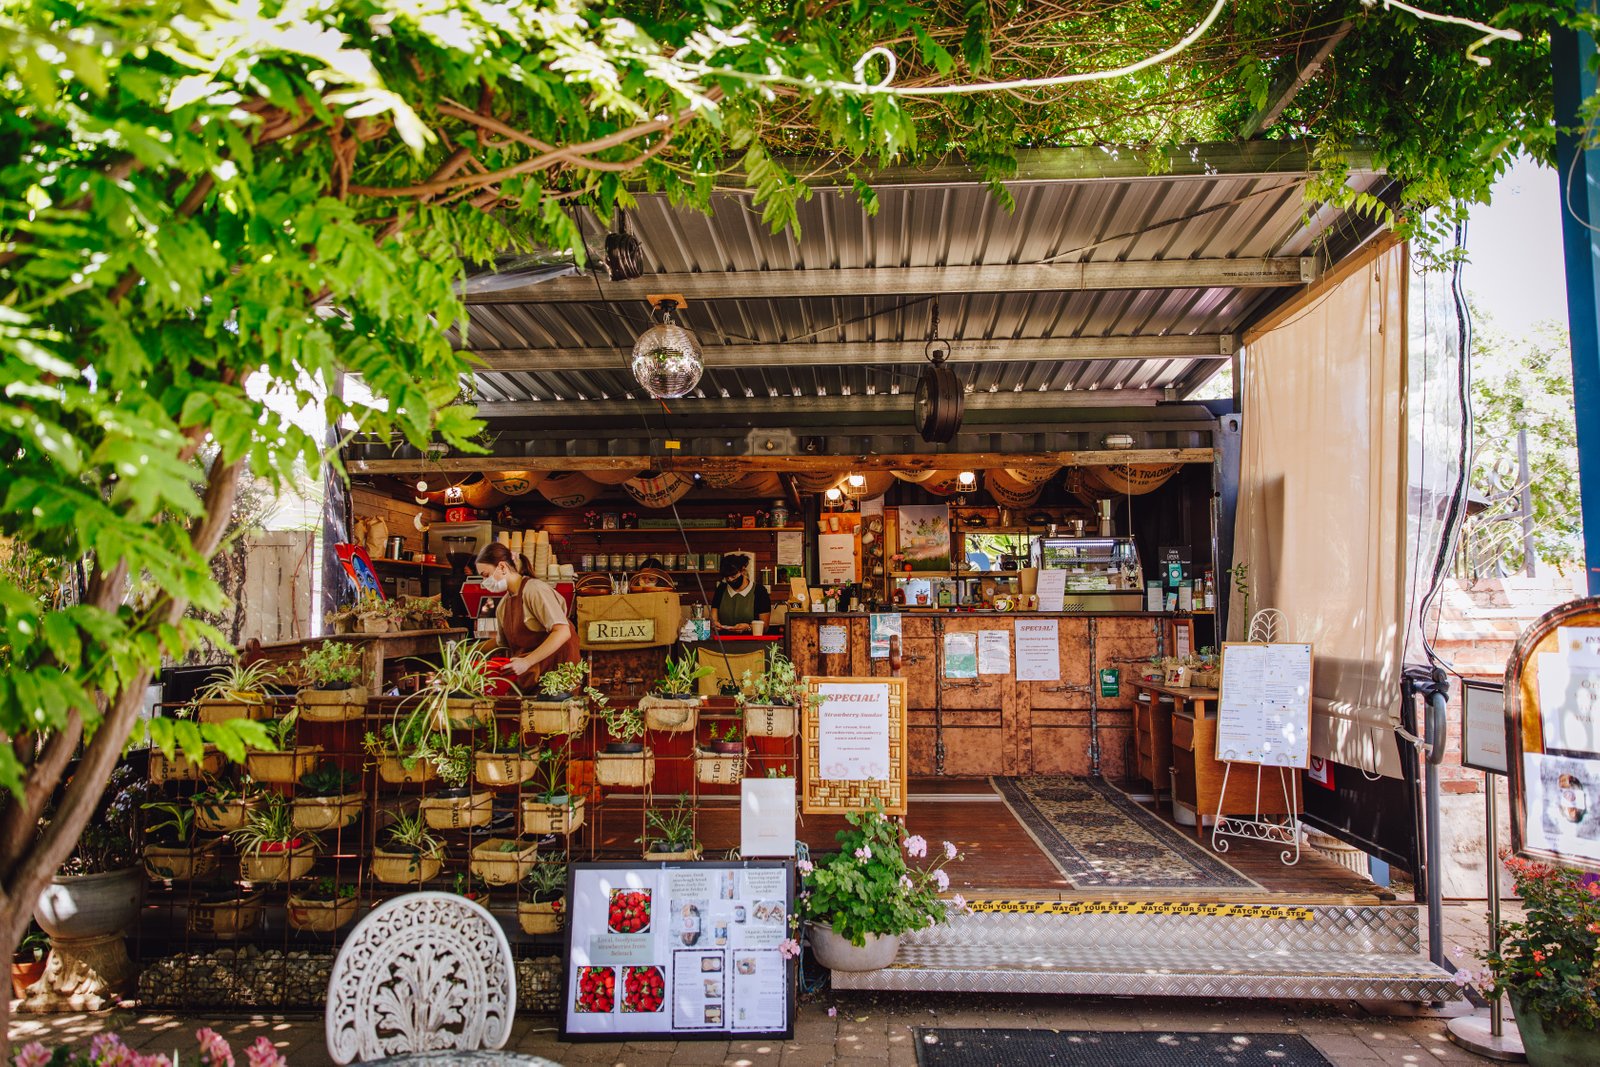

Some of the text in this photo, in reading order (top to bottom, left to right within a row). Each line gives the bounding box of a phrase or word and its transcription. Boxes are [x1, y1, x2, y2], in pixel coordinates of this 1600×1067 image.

[597, 623, 647, 639] RELAX
[826, 693, 881, 703] SPECIAL!
[765, 707, 775, 736] COFFEE
[1171, 905, 1195, 913] YOUR
